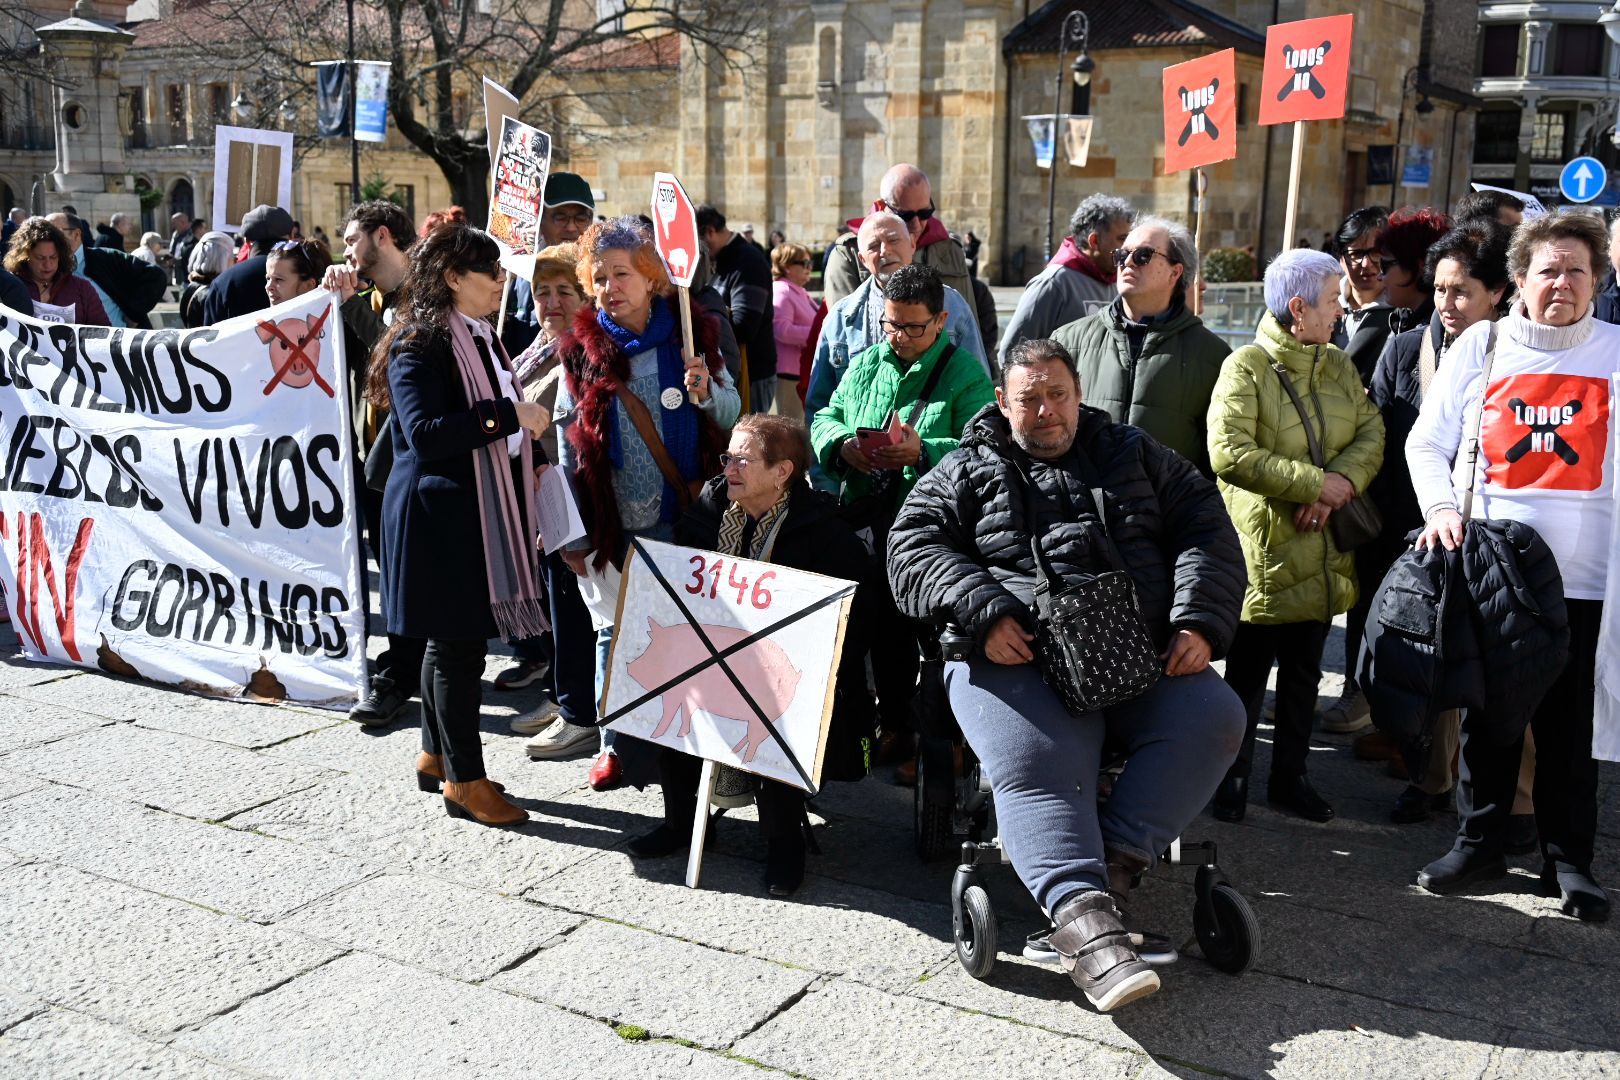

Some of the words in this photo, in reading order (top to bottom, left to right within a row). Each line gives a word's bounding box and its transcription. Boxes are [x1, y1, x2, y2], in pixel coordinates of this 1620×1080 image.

[1285, 46, 1325, 70] LODOS
[1293, 72, 1311, 92] NO
[1181, 84, 1215, 113] LODOS
[1191, 112, 1206, 135] NO
[498, 191, 536, 215] BIOMASA
[660, 188, 676, 203] STOP
[0, 315, 232, 415] UEREMOS
[1515, 405, 1573, 425] LODOS
[1531, 432, 1555, 453] NO
[174, 434, 344, 530] VIVOS
[0, 510, 95, 663] IN
[111, 559, 350, 660] GORRINOS
[685, 555, 777, 610] 3.146
